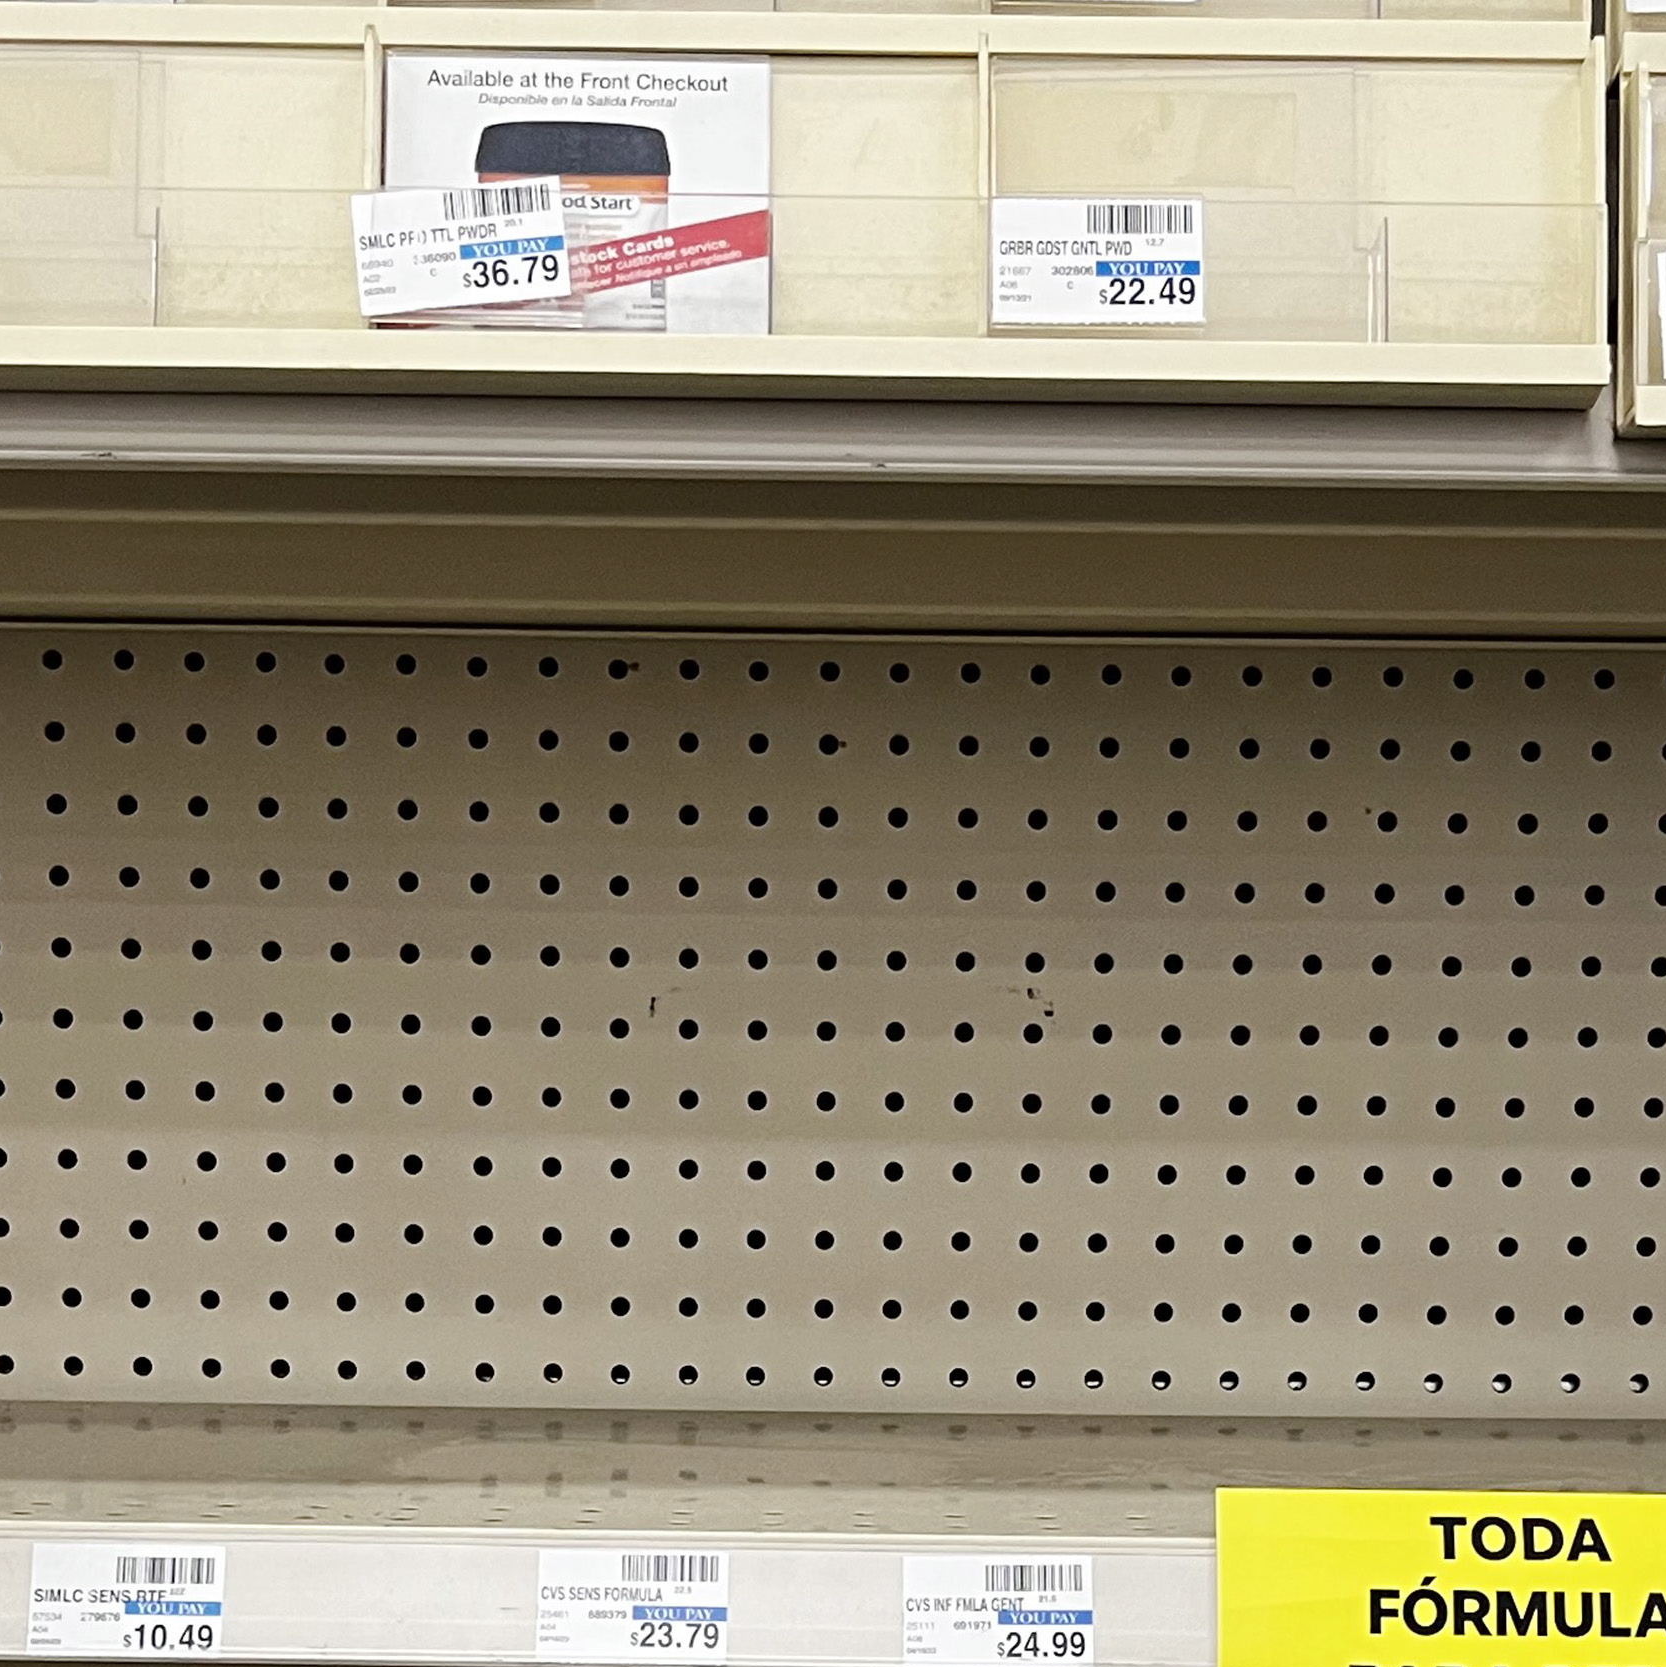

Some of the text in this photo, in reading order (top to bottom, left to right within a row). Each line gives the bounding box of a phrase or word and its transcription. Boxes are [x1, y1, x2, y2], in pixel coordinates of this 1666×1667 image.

[428, 70, 729, 92] Available at the Front Checkout
[590, 197, 632, 210] Start
[623, 236, 674, 256] Cards
[1000, 241, 1132, 255] GRBR GDST GNTL PWD
[463, 255, 559, 288] $36.79
[1100, 277, 1195, 305] $22.49
[1429, 1516, 1612, 1562] TODA
[541, 1586, 662, 1602] CVS SENS FORMULA
[906, 1598, 1024, 1613] CVS INF FMLA GENT
[123, 1624, 213, 1651] $10.49
[630, 1621, 719, 1648] $23.79
[997, 1631, 1086, 1658] $24.99
